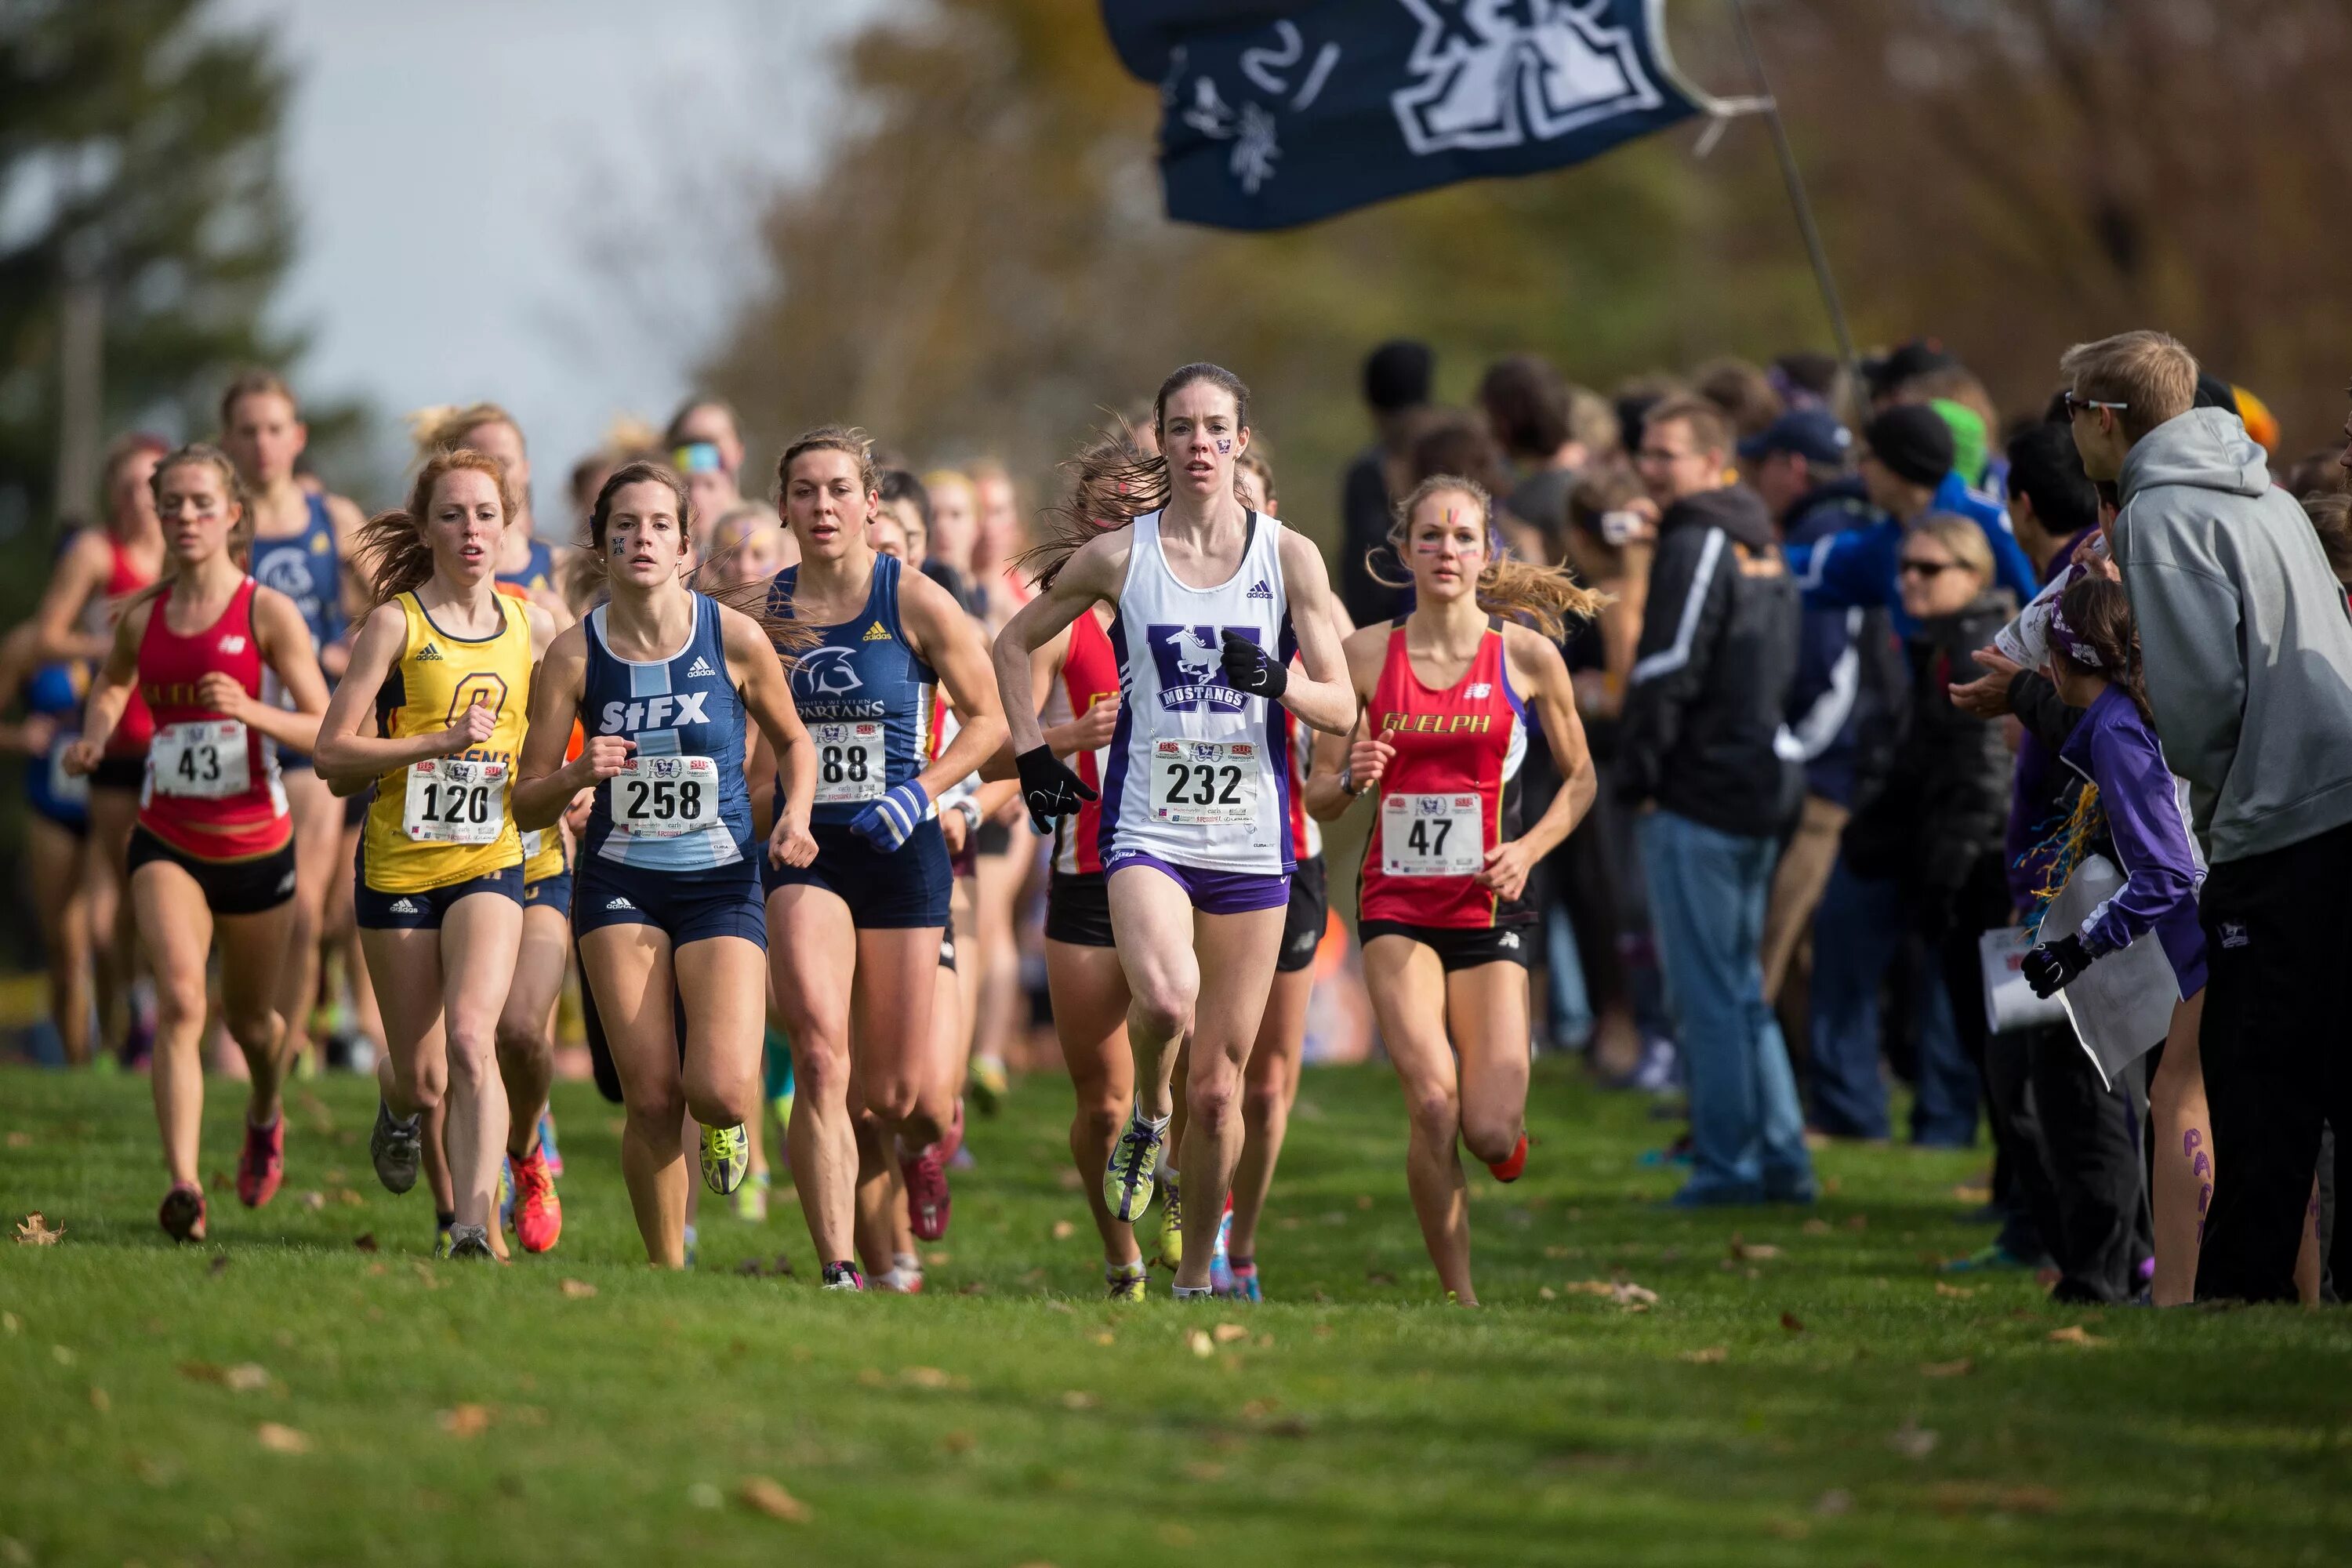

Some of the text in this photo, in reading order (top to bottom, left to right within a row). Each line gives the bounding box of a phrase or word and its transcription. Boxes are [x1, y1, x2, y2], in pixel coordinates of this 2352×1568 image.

[1247, 590, 1274, 600] adidas
[863, 632, 892, 641] adidas
[688, 668, 716, 678] adidas
[796, 699, 885, 720] PARTANS
[1163, 687, 1244, 707] MUSTANGS
[599, 691, 711, 734] StFX
[1382, 712, 1491, 734] GUELPH
[179, 745, 221, 782] 43
[817, 746, 868, 783] 88
[1167, 763, 1242, 805] 232
[422, 783, 488, 824] 120
[627, 780, 701, 820] 258
[1408, 818, 1453, 856] 47
[389, 906, 419, 914] adidas
